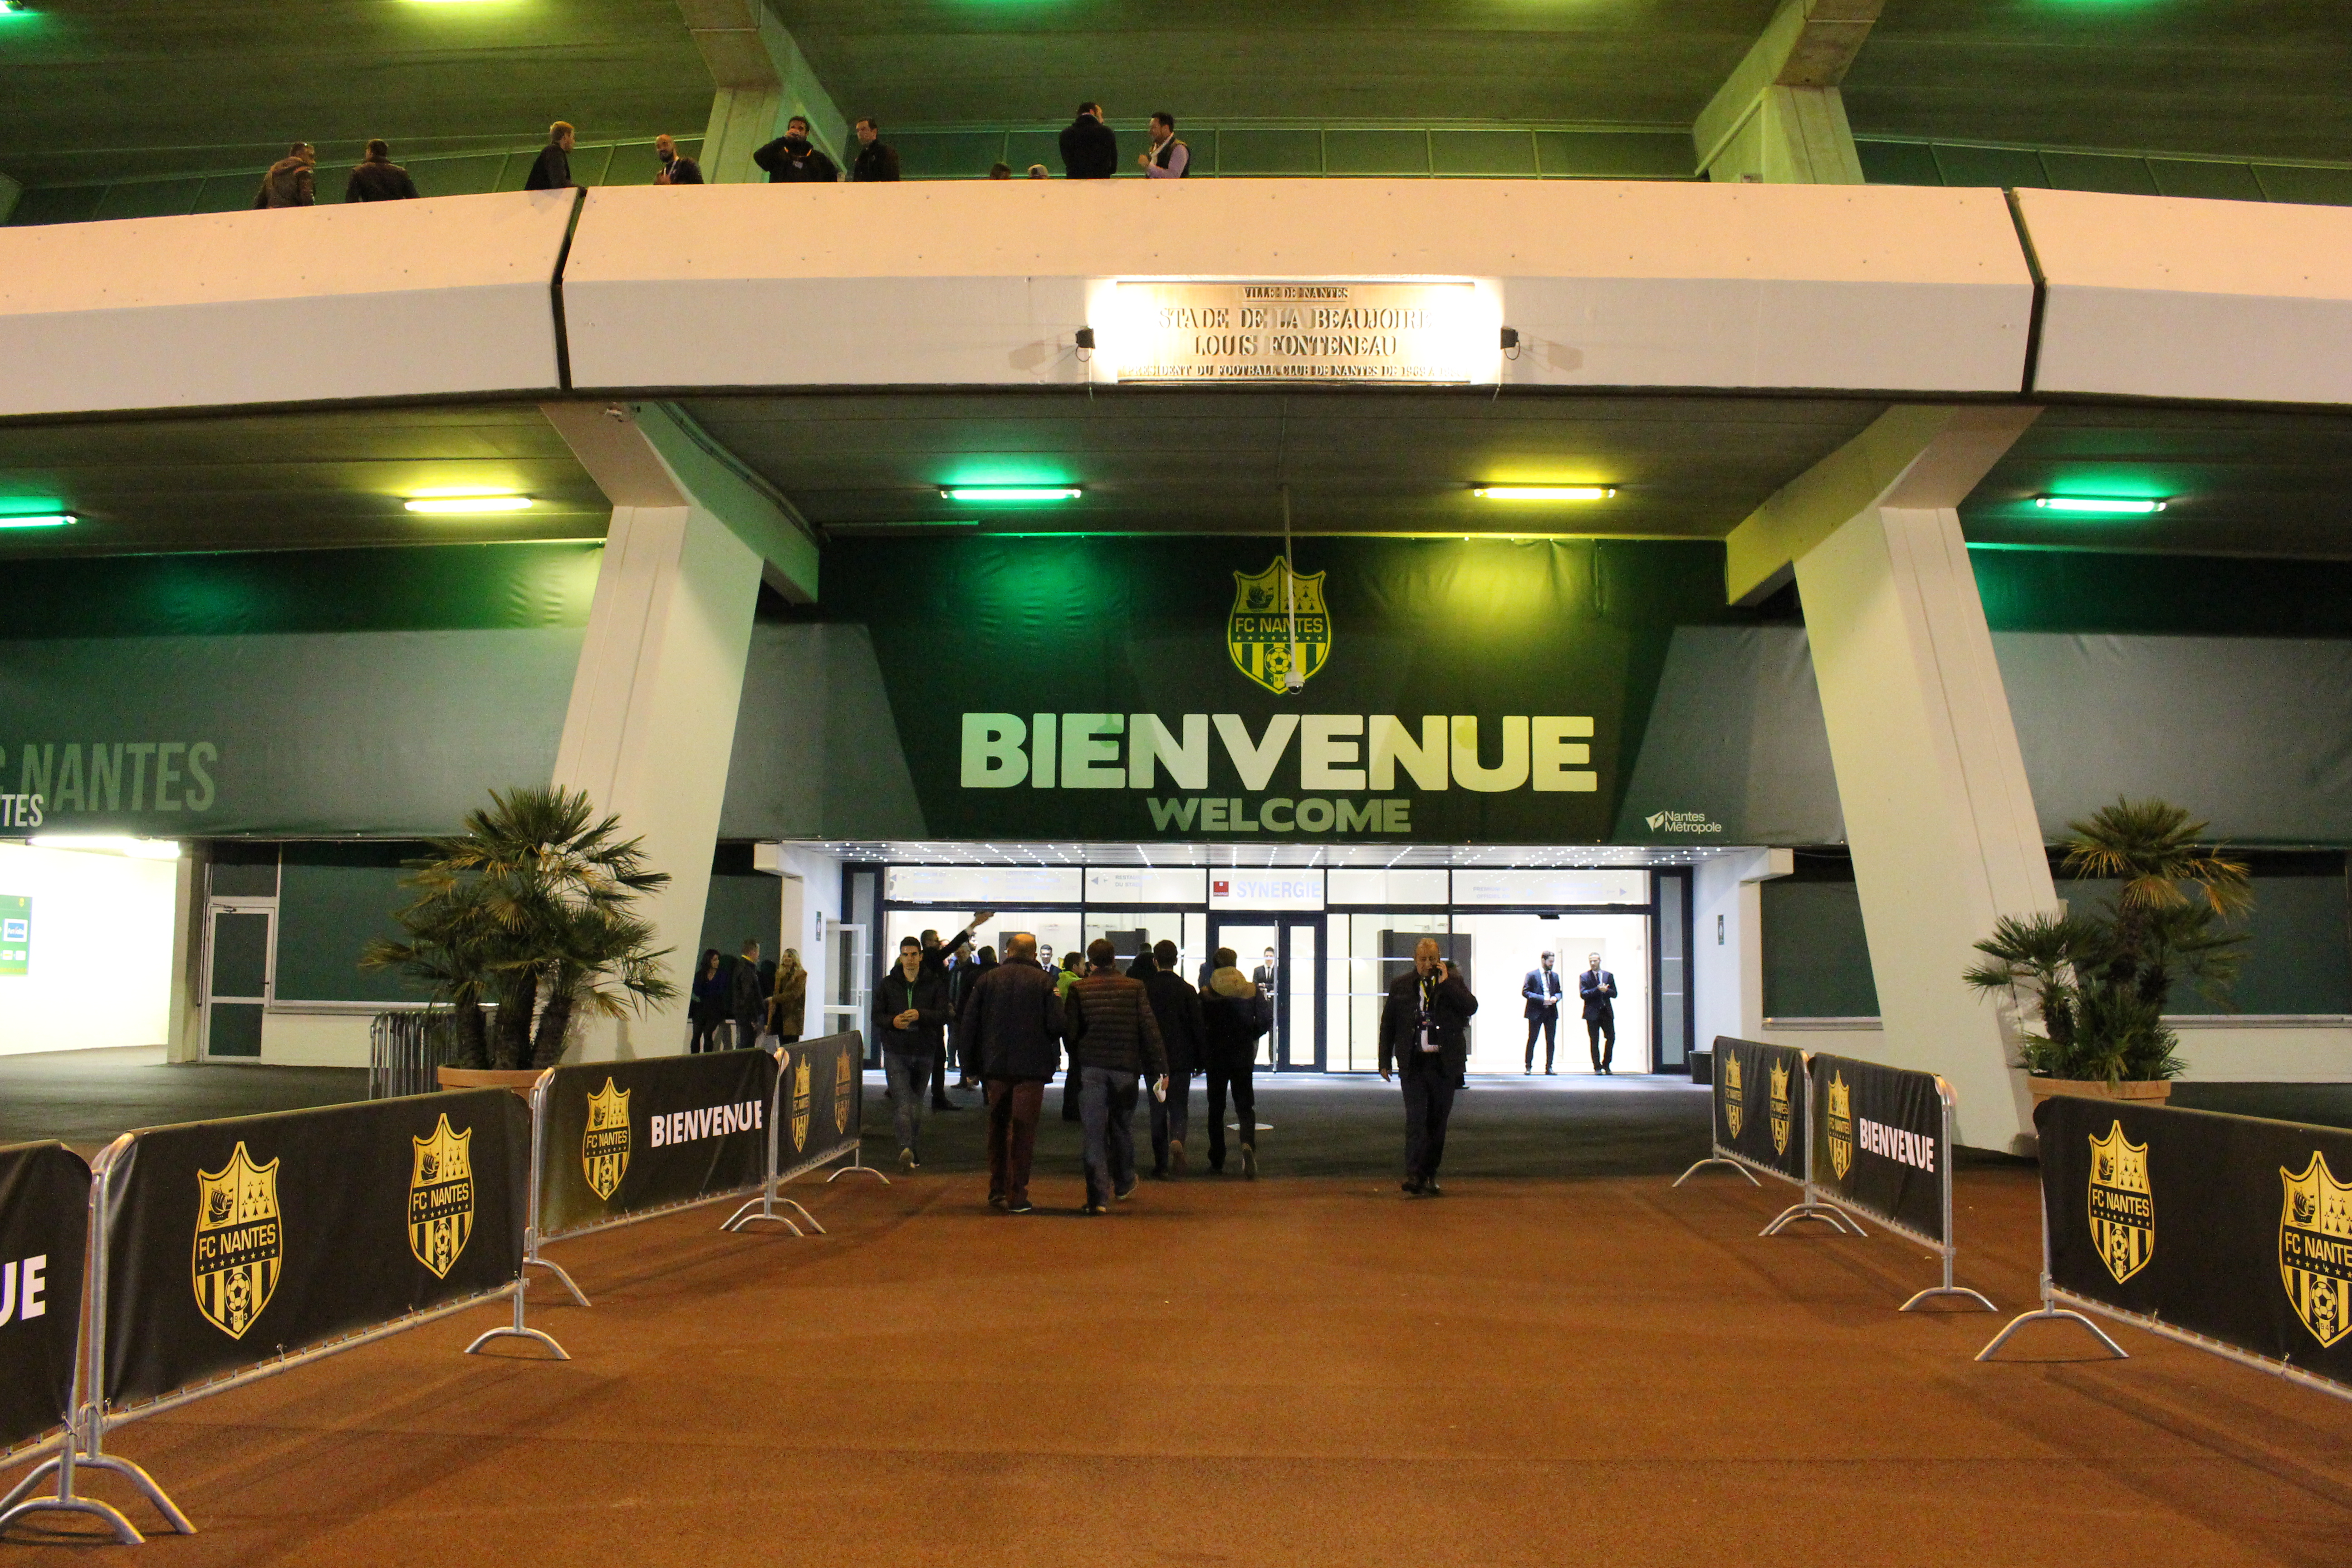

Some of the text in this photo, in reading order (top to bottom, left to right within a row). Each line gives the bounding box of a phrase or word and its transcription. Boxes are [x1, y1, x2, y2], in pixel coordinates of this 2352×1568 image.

[1244, 287, 1348, 298] VILLE DE NANTES
[1159, 308, 1433, 329] STADE DE LA BEAUJOIRE
[1193, 335, 1396, 356] LOUIS FONTENEAU
[1196, 365, 1214, 376] DU
[1218, 365, 1277, 376] FOOTBALL
[1280, 365, 1308, 376] CLUB
[1315, 365, 1328, 376] DE
[1332, 365, 1378, 376] NANTES
[1382, 366, 1397, 376] DE
[1401, 365, 1426, 377] 1969
[1235, 617, 1323, 633] FC NANTES
[960, 713, 1598, 793] BIENVENUE
[21, 742, 218, 811] NANTES
[0, 794, 44, 827] TES
[1147, 797, 1411, 833] WELCOME
[1665, 810, 1705, 822] Nantes
[1665, 822, 1722, 834] Métropole
[1236, 881, 1321, 898] SYNERGIE
[651, 1100, 762, 1147] BIENVENUE
[587, 1130, 627, 1149] FC NANTES
[1860, 1117, 1934, 1173] BIENVENUE
[413, 1183, 469, 1211] FC NANTES
[2092, 1189, 2150, 1217] FC NANTES
[199, 1224, 276, 1260] FC NANTES
[2285, 1231, 2301, 1254] FC
[230, 1313, 248, 1324] 1943
